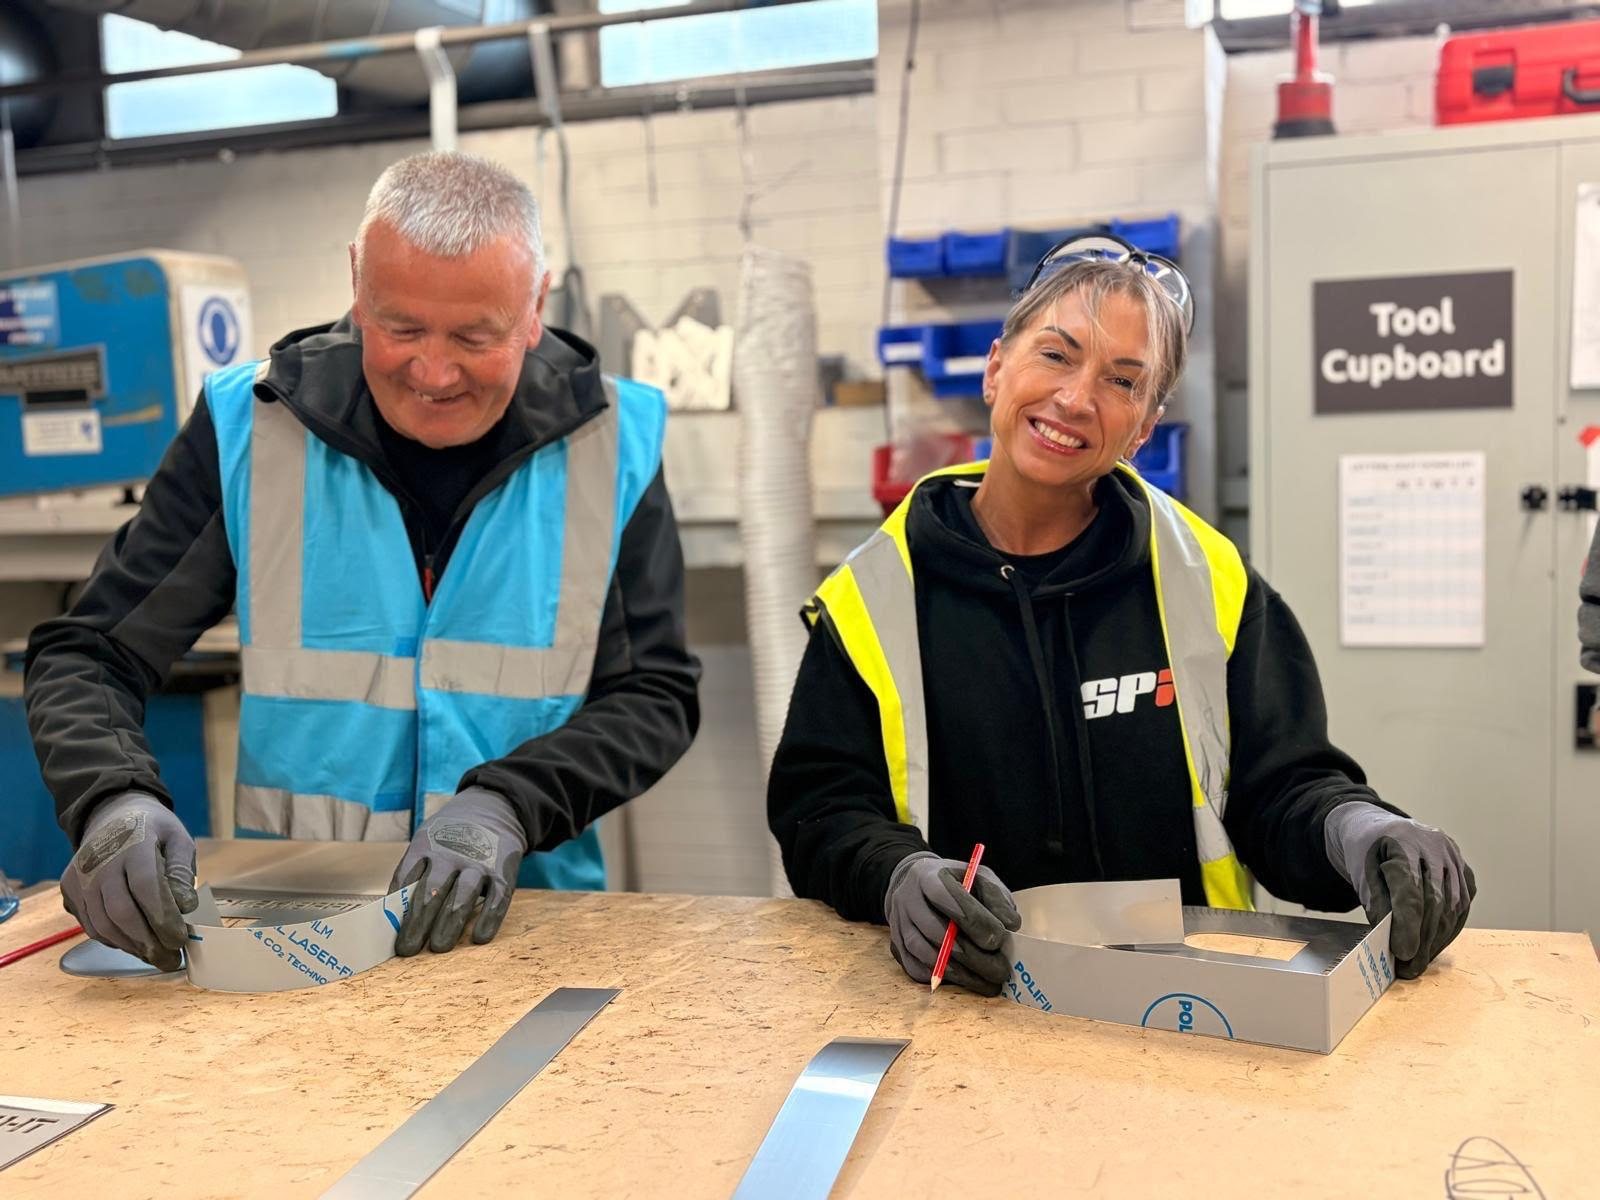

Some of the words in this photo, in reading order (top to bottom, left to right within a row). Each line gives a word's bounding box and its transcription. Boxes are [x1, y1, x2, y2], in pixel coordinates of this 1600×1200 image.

[1369, 296, 1456, 337] Tool
[1321, 338, 1506, 389] Cupboard
[310, 920, 333, 939] ILM
[286, 953, 330, 985] TECHNO
[288, 930, 355, 977] LASER-FI
[1178, 1000, 1193, 1032] POL
